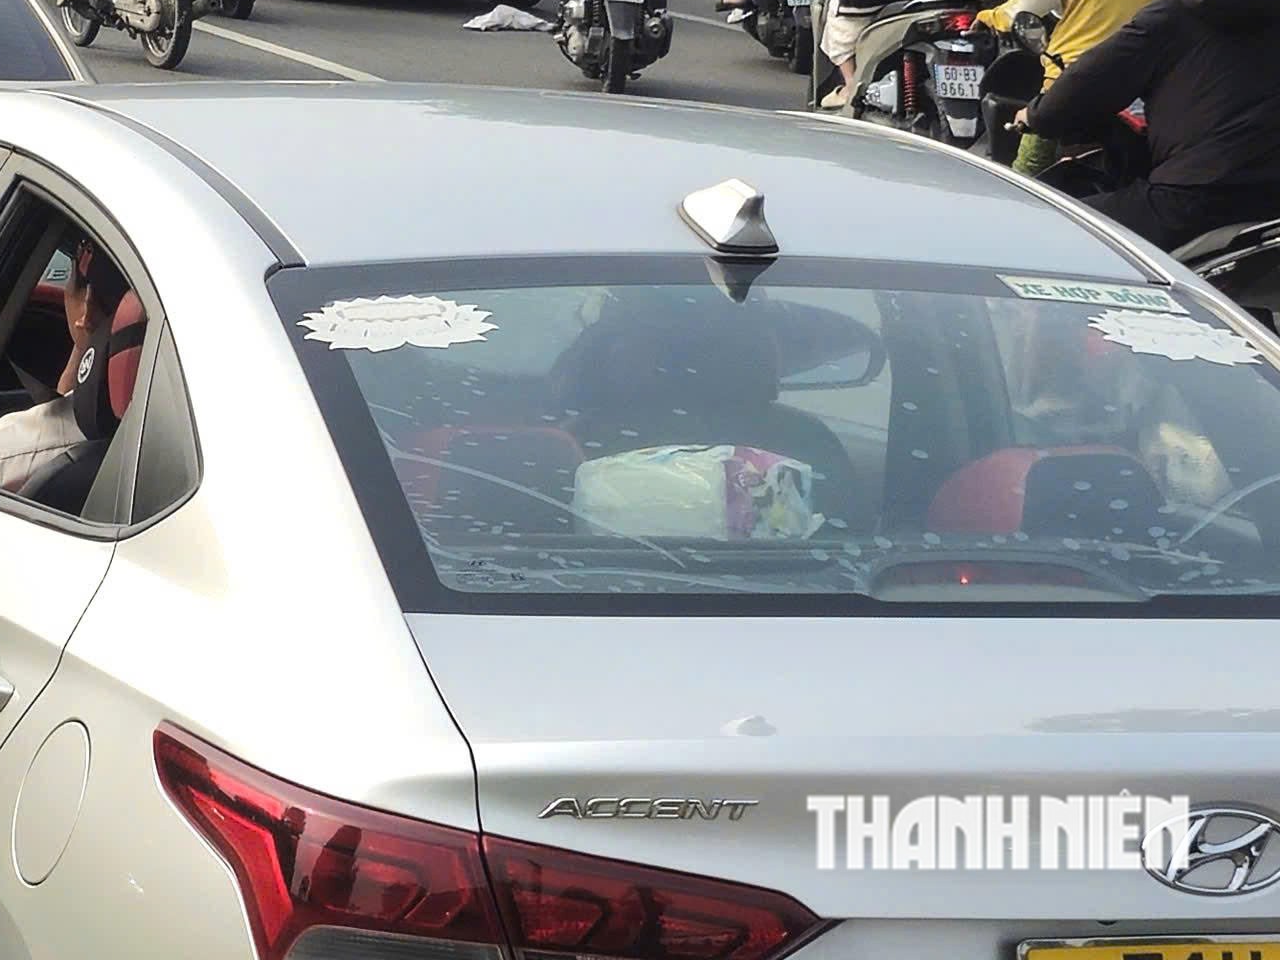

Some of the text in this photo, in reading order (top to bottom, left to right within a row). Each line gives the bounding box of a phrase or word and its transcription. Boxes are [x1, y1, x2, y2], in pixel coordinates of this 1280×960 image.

[943, 67, 977, 81] 60-B3
[1015, 282, 1051, 297] XE
[1053, 285, 1102, 303] HỢP
[536, 798, 759, 821] ACCENT
